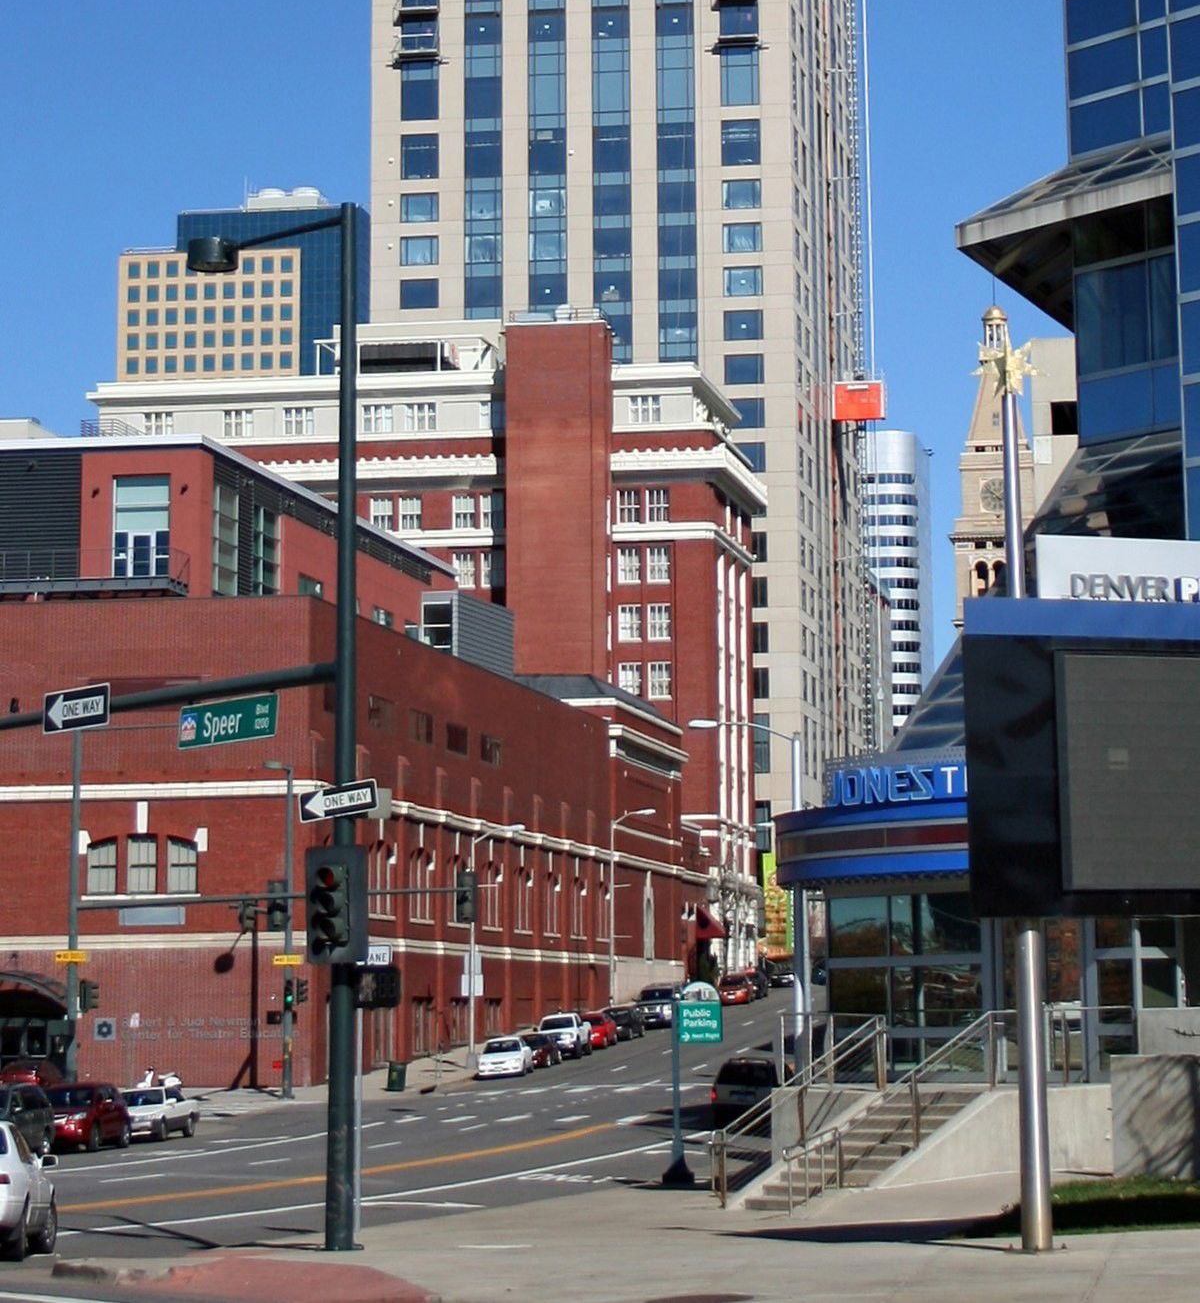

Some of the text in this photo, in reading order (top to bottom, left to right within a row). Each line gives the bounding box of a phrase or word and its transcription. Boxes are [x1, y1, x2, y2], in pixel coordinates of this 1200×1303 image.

[1070, 574, 1170, 601] DENVER
[62, 697, 102, 718] ONE WAY
[255, 703, 270, 716] Blvd
[202, 712, 243, 743] Speer
[828, 764, 935, 807] JONES
[324, 789, 369, 808] ONE WAY
[368, 952, 388, 963] ANE
[683, 1009, 712, 1018] Public
[122, 1017, 161, 1027] Rbert
[167, 1017, 175, 1027] &
[683, 1018, 718, 1029] Parking
[168, 1028, 181, 1039] for
[239, 1027, 300, 1039] Educatin
